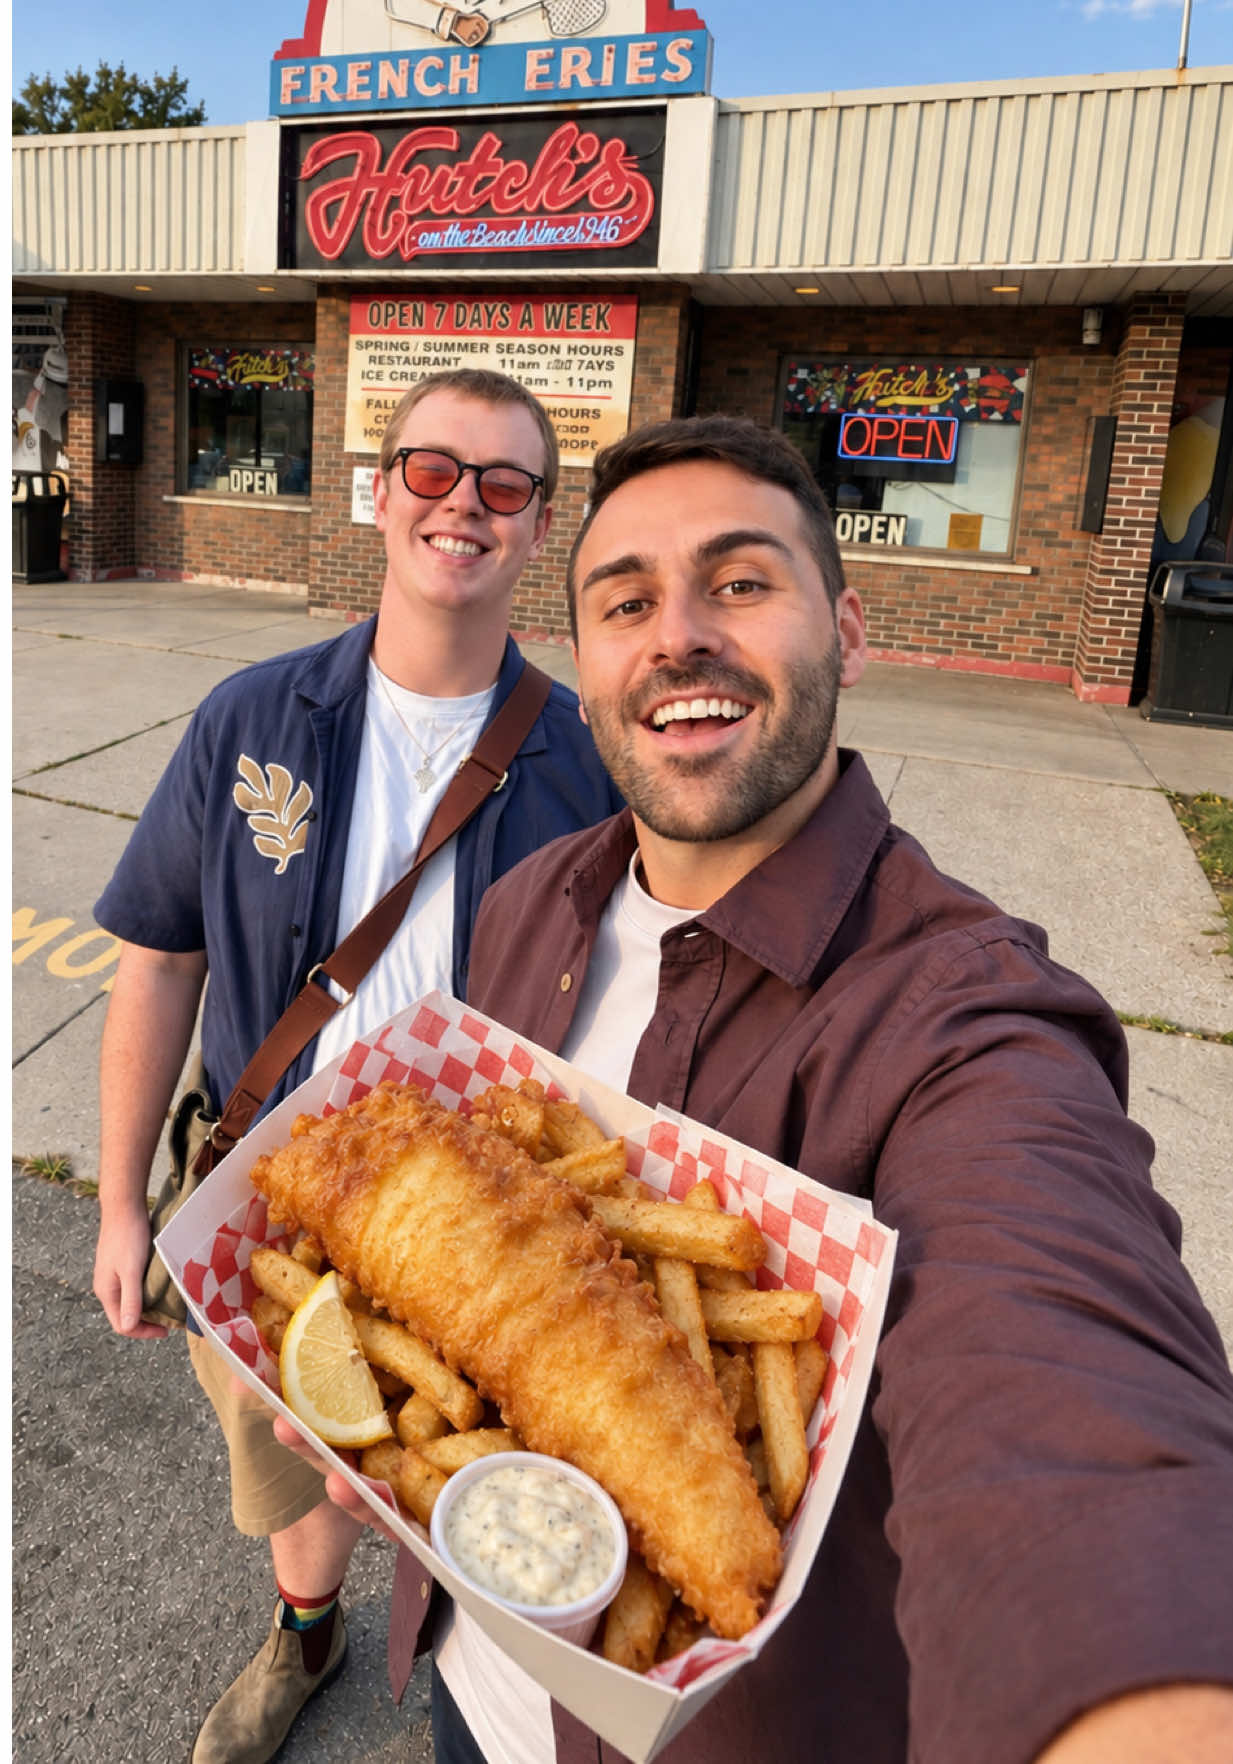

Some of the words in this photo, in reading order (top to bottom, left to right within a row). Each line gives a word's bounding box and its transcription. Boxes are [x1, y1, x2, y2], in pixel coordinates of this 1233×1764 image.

[280, 54, 479, 104] FRENCH
[301, 121, 654, 261] Hutch's
[368, 302, 425, 329] OPEN
[435, 303, 448, 329] 7
[455, 303, 511, 330] DAYS
[519, 303, 534, 330] A
[545, 303, 612, 331] WEEK
[355, 340, 410, 352] SPRING
[423, 342, 489, 354] SUMMER
[495, 343, 561, 355] SEASON
[567, 345, 624, 357] HOURS
[368, 355, 462, 367] RESTAURANT
[500, 359, 541, 370] 11am
[361, 371, 385, 381] ICE
[568, 377, 613, 391] 11pm
[547, 407, 601, 419] HOURS
[842, 416, 956, 461] OPEN
[229, 469, 279, 496] OPEN
[835, 513, 907, 547] OPEN
